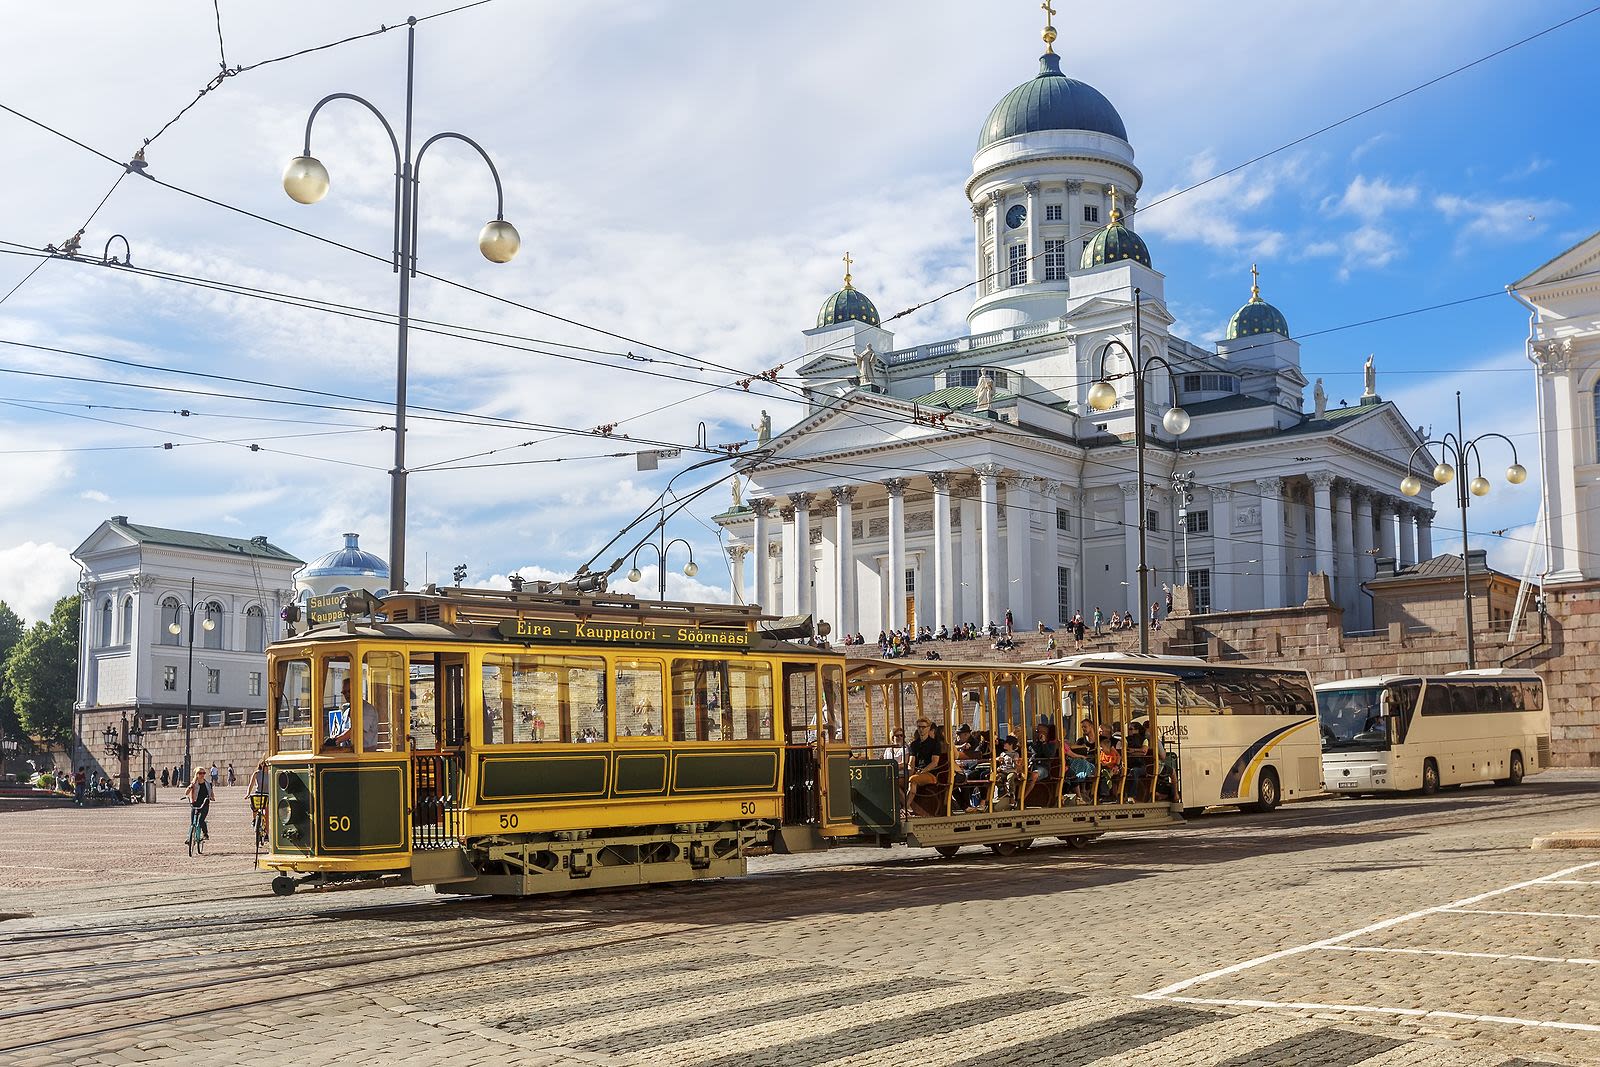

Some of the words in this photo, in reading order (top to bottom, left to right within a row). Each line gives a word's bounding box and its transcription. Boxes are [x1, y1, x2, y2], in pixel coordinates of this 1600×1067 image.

[516, 620, 551, 636] Eira
[575, 623, 656, 641] Kauppatori
[677, 628, 748, 644] Söörnääsi
[741, 801, 756, 815] 50
[329, 816, 351, 831] 50
[500, 814, 519, 829] 50
